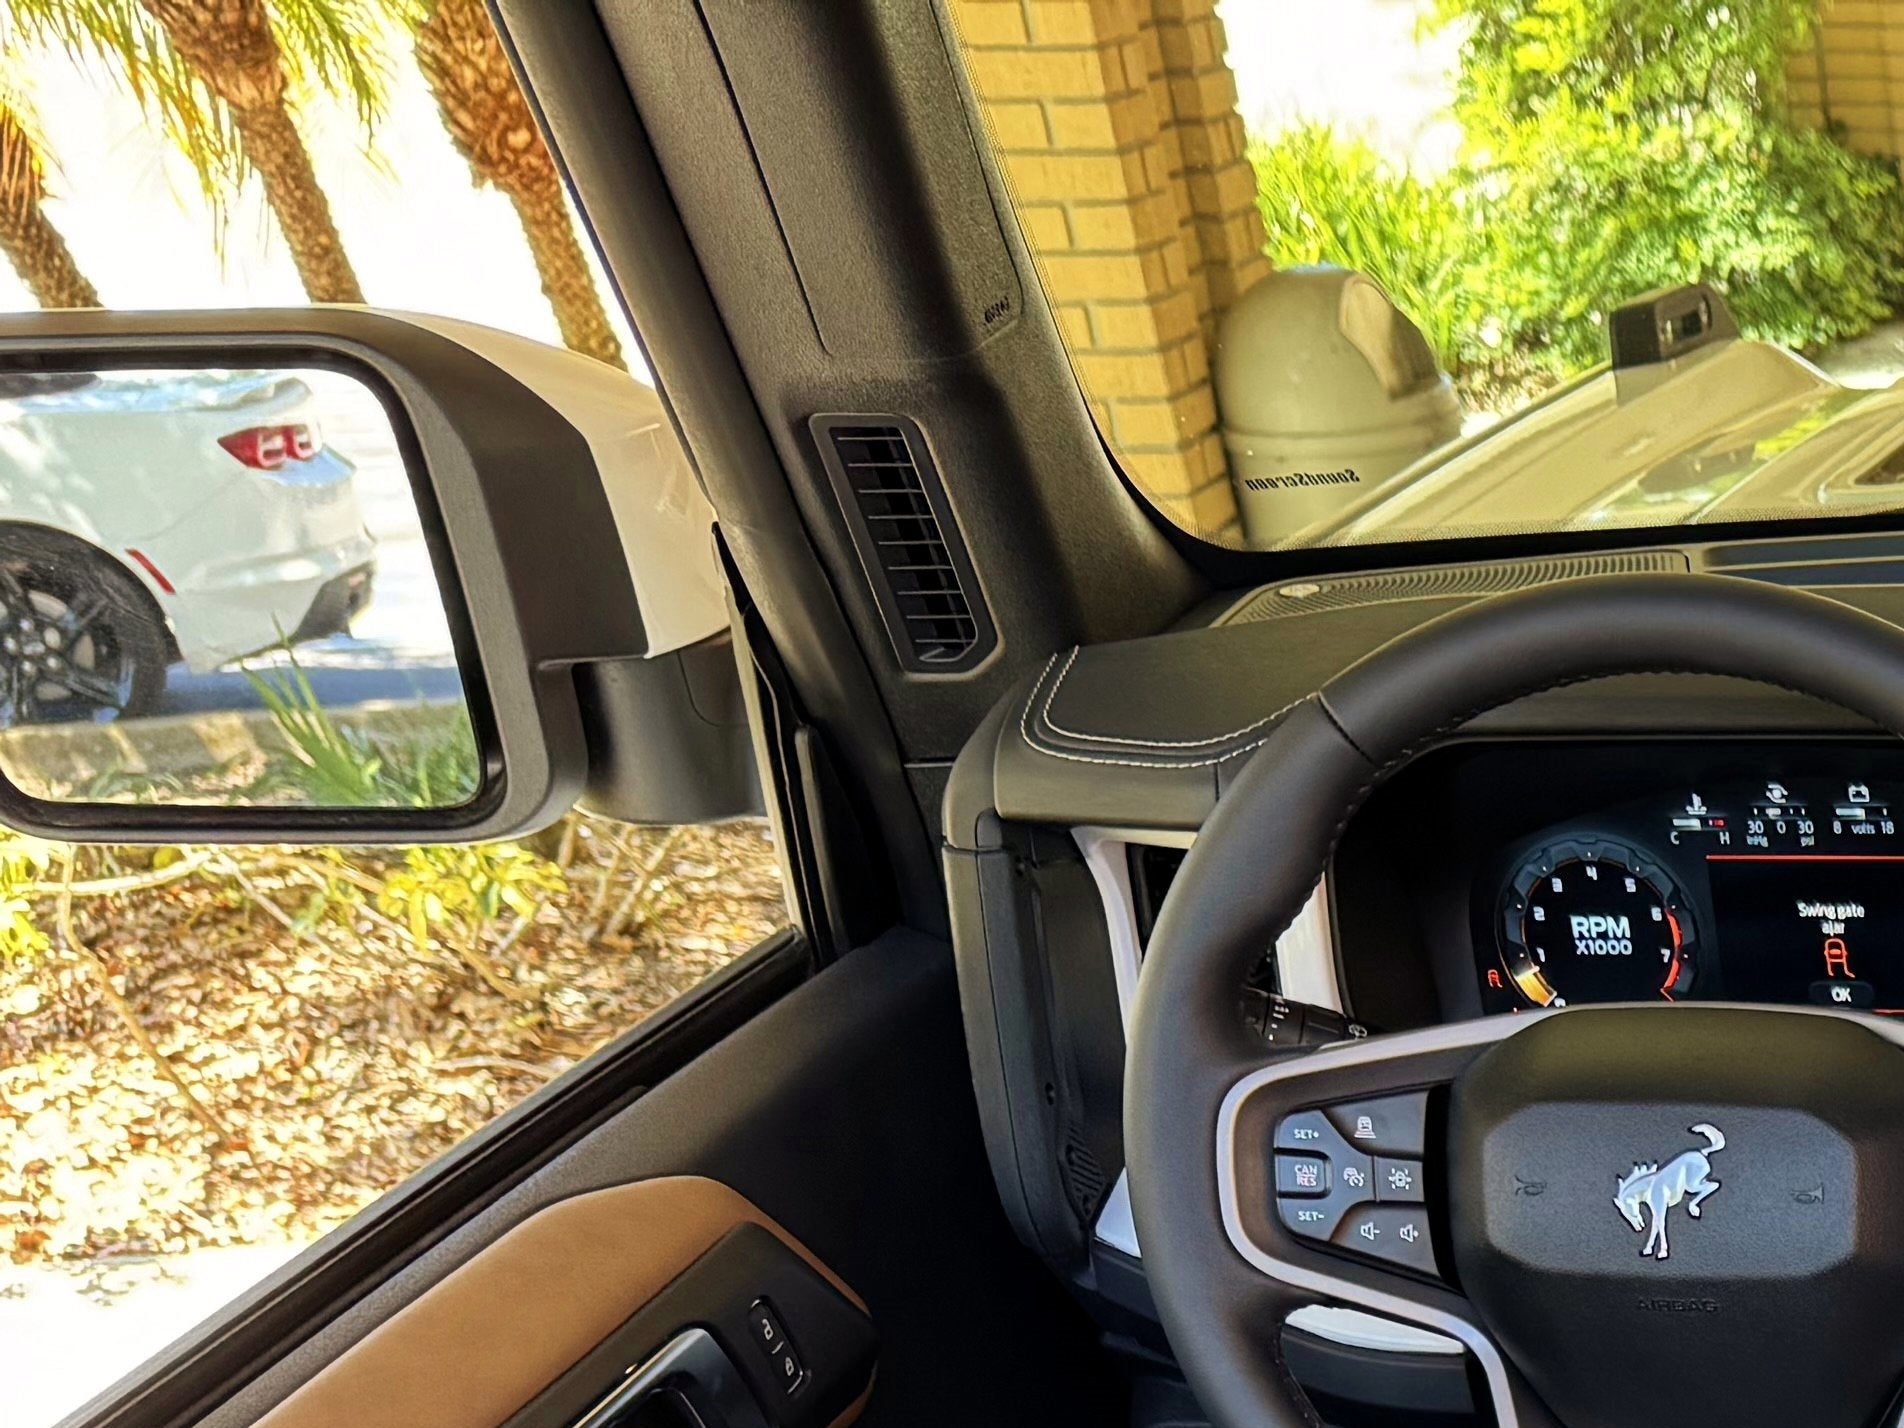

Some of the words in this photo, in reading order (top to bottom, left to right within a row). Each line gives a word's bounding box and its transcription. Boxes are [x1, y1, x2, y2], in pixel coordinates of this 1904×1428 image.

[1571, 916, 1631, 938] RPM
[1830, 986, 1852, 1002] OK
[1294, 1164, 1317, 1175] CAN
[1637, 1298, 1719, 1313] AIRBAG
